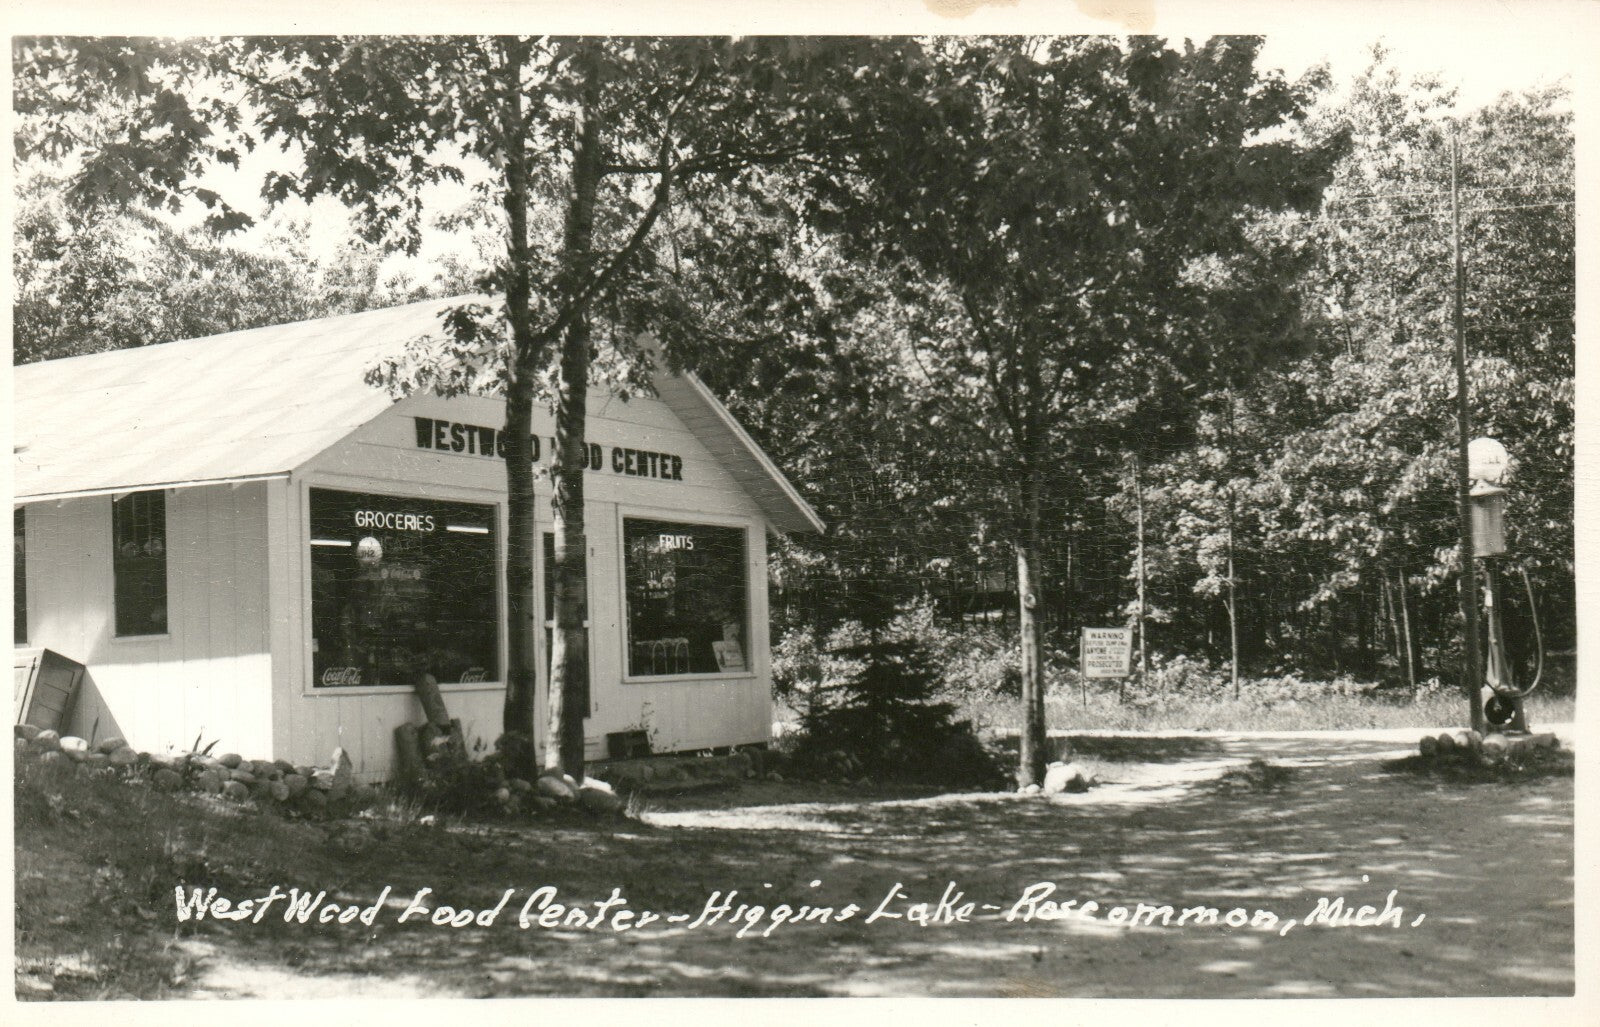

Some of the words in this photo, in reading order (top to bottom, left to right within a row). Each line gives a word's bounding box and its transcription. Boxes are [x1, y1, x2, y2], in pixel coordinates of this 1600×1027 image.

[415, 416, 541, 463] WESTWOD
[612, 446, 683, 481] CENTER
[355, 511, 434, 532] GROCERIES
[659, 534, 694, 550] FRUITS
